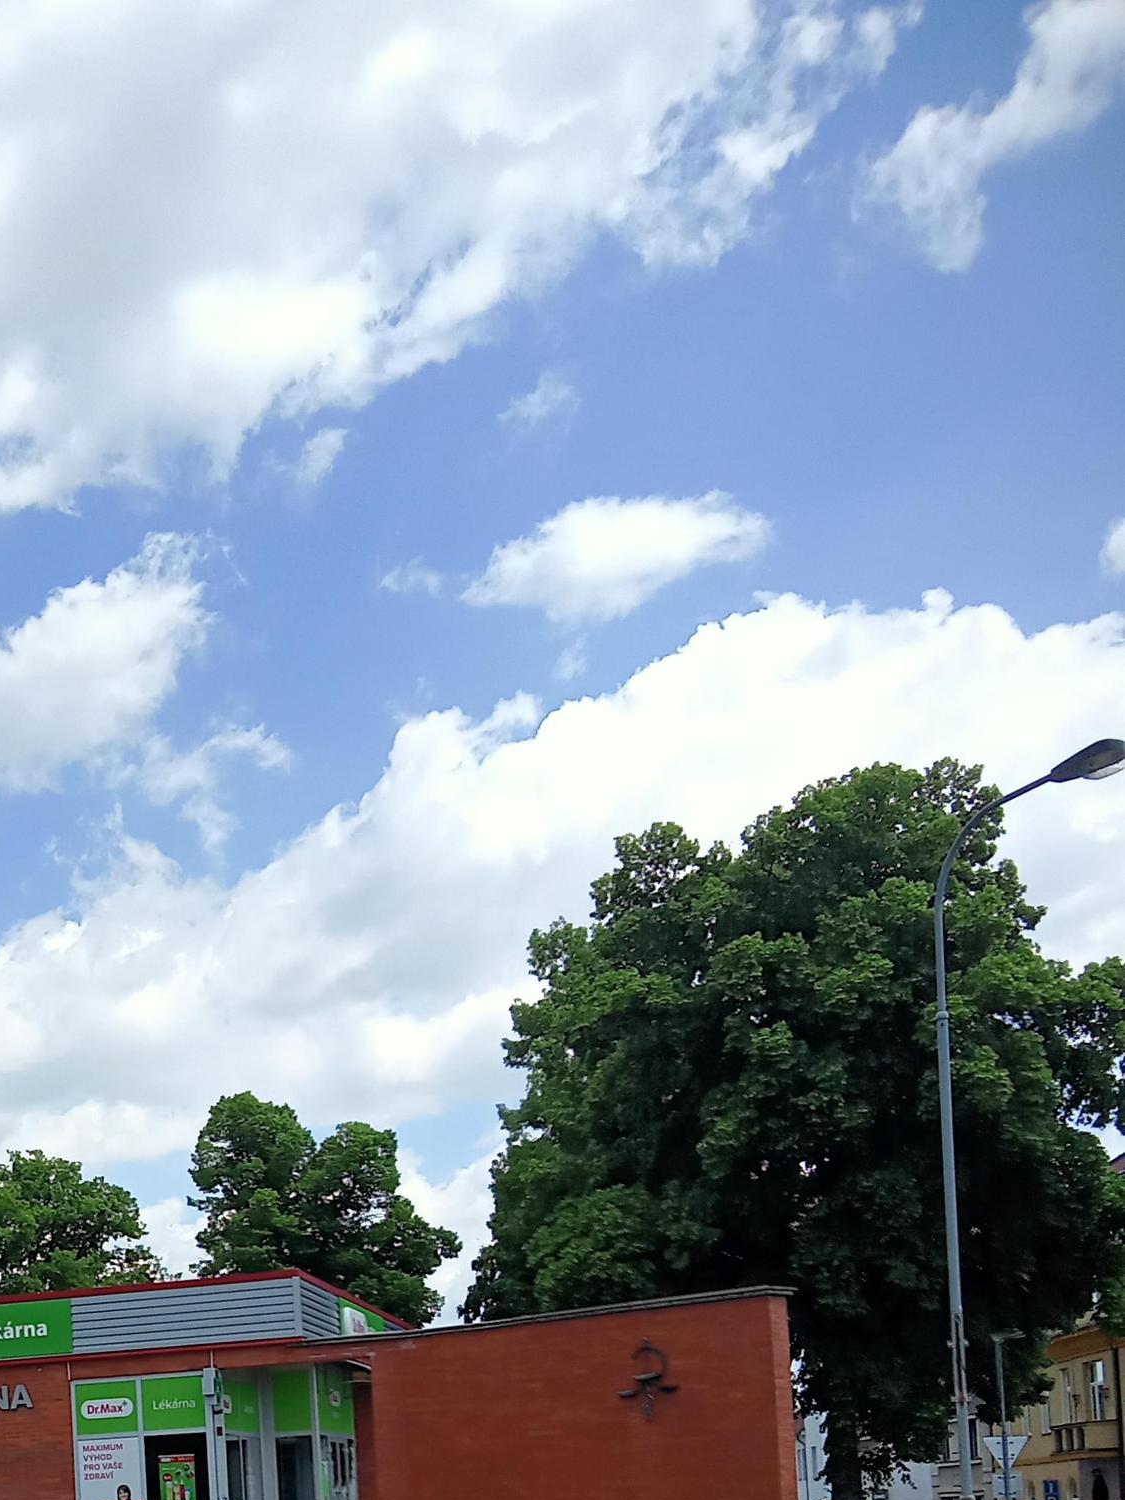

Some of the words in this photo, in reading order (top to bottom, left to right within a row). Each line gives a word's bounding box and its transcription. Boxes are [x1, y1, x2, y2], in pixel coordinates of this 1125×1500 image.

[87, 1404, 123, 1414] Dr.Max
[153, 1399, 195, 1410] Lékárna
[83, 1444, 123, 1452] MAXIMUM
[83, 1453, 112, 1461] VÝHOD
[83, 1463, 101, 1471] PRO
[102, 1462, 124, 1470] VAŠE
[84, 1471, 113, 1480] ZDRAVÍ
